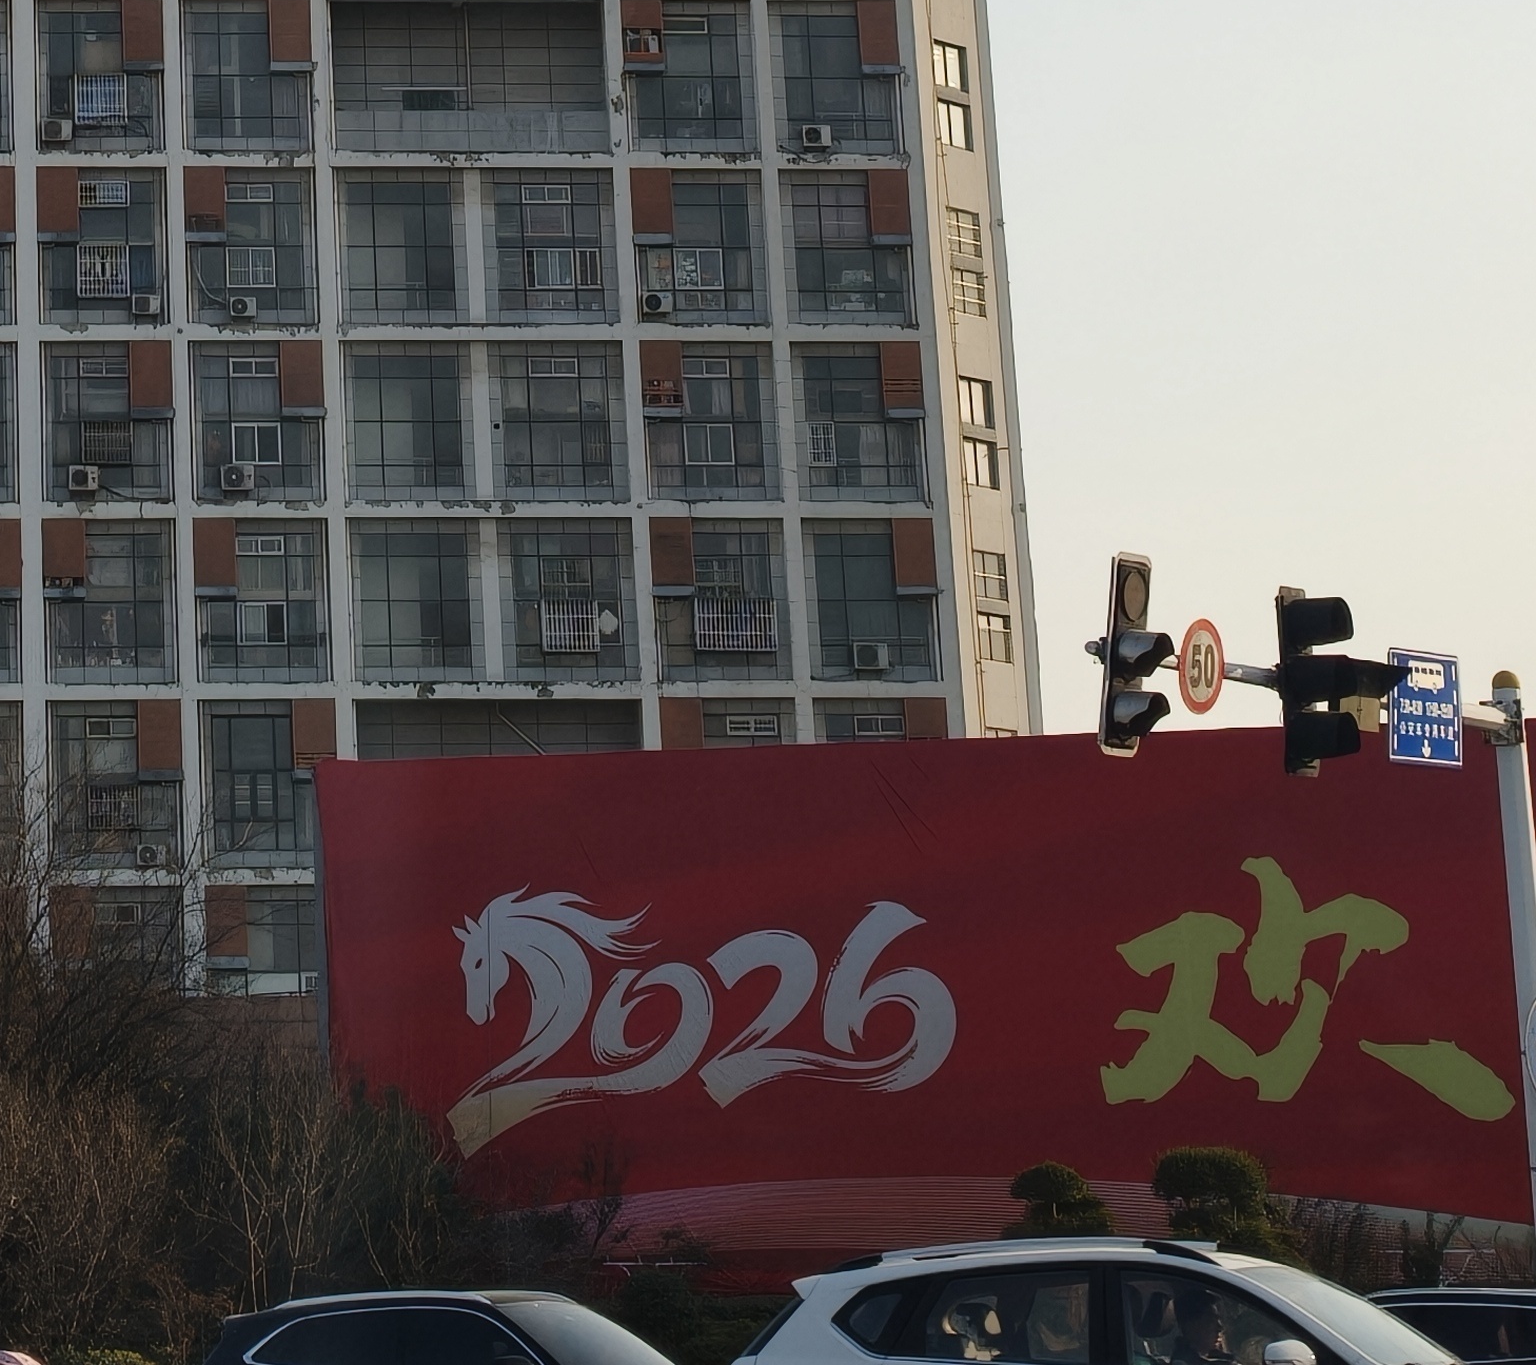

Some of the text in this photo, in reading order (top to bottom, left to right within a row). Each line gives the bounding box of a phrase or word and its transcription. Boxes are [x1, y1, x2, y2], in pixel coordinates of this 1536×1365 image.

[1189, 644, 1215, 689] 50
[448, 858, 1516, 1158] 2026 欢
